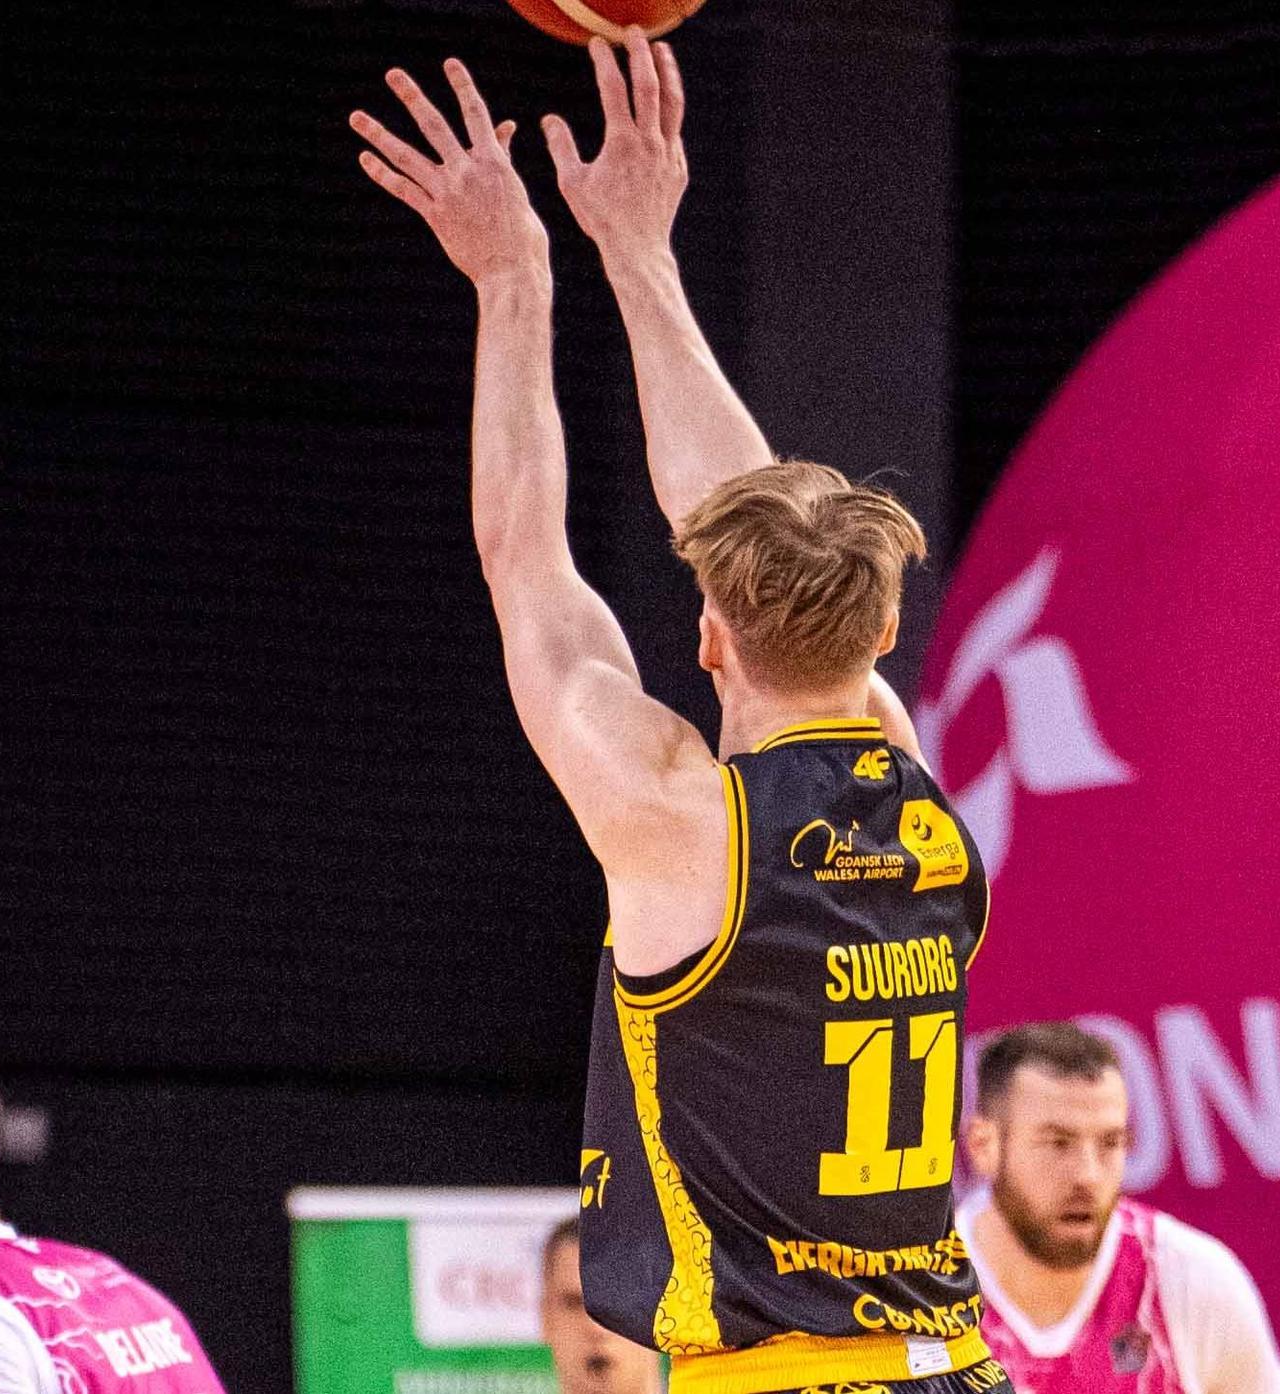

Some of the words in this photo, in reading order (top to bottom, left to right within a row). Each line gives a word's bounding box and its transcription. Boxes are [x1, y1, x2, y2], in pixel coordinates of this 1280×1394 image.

[814, 867, 861, 882] WALESA
[862, 866, 904, 880] AIRPORT
[835, 854, 882, 869] GDANSK
[824, 934, 958, 1003] SUURORG
[818, 1010, 957, 1197] 11
